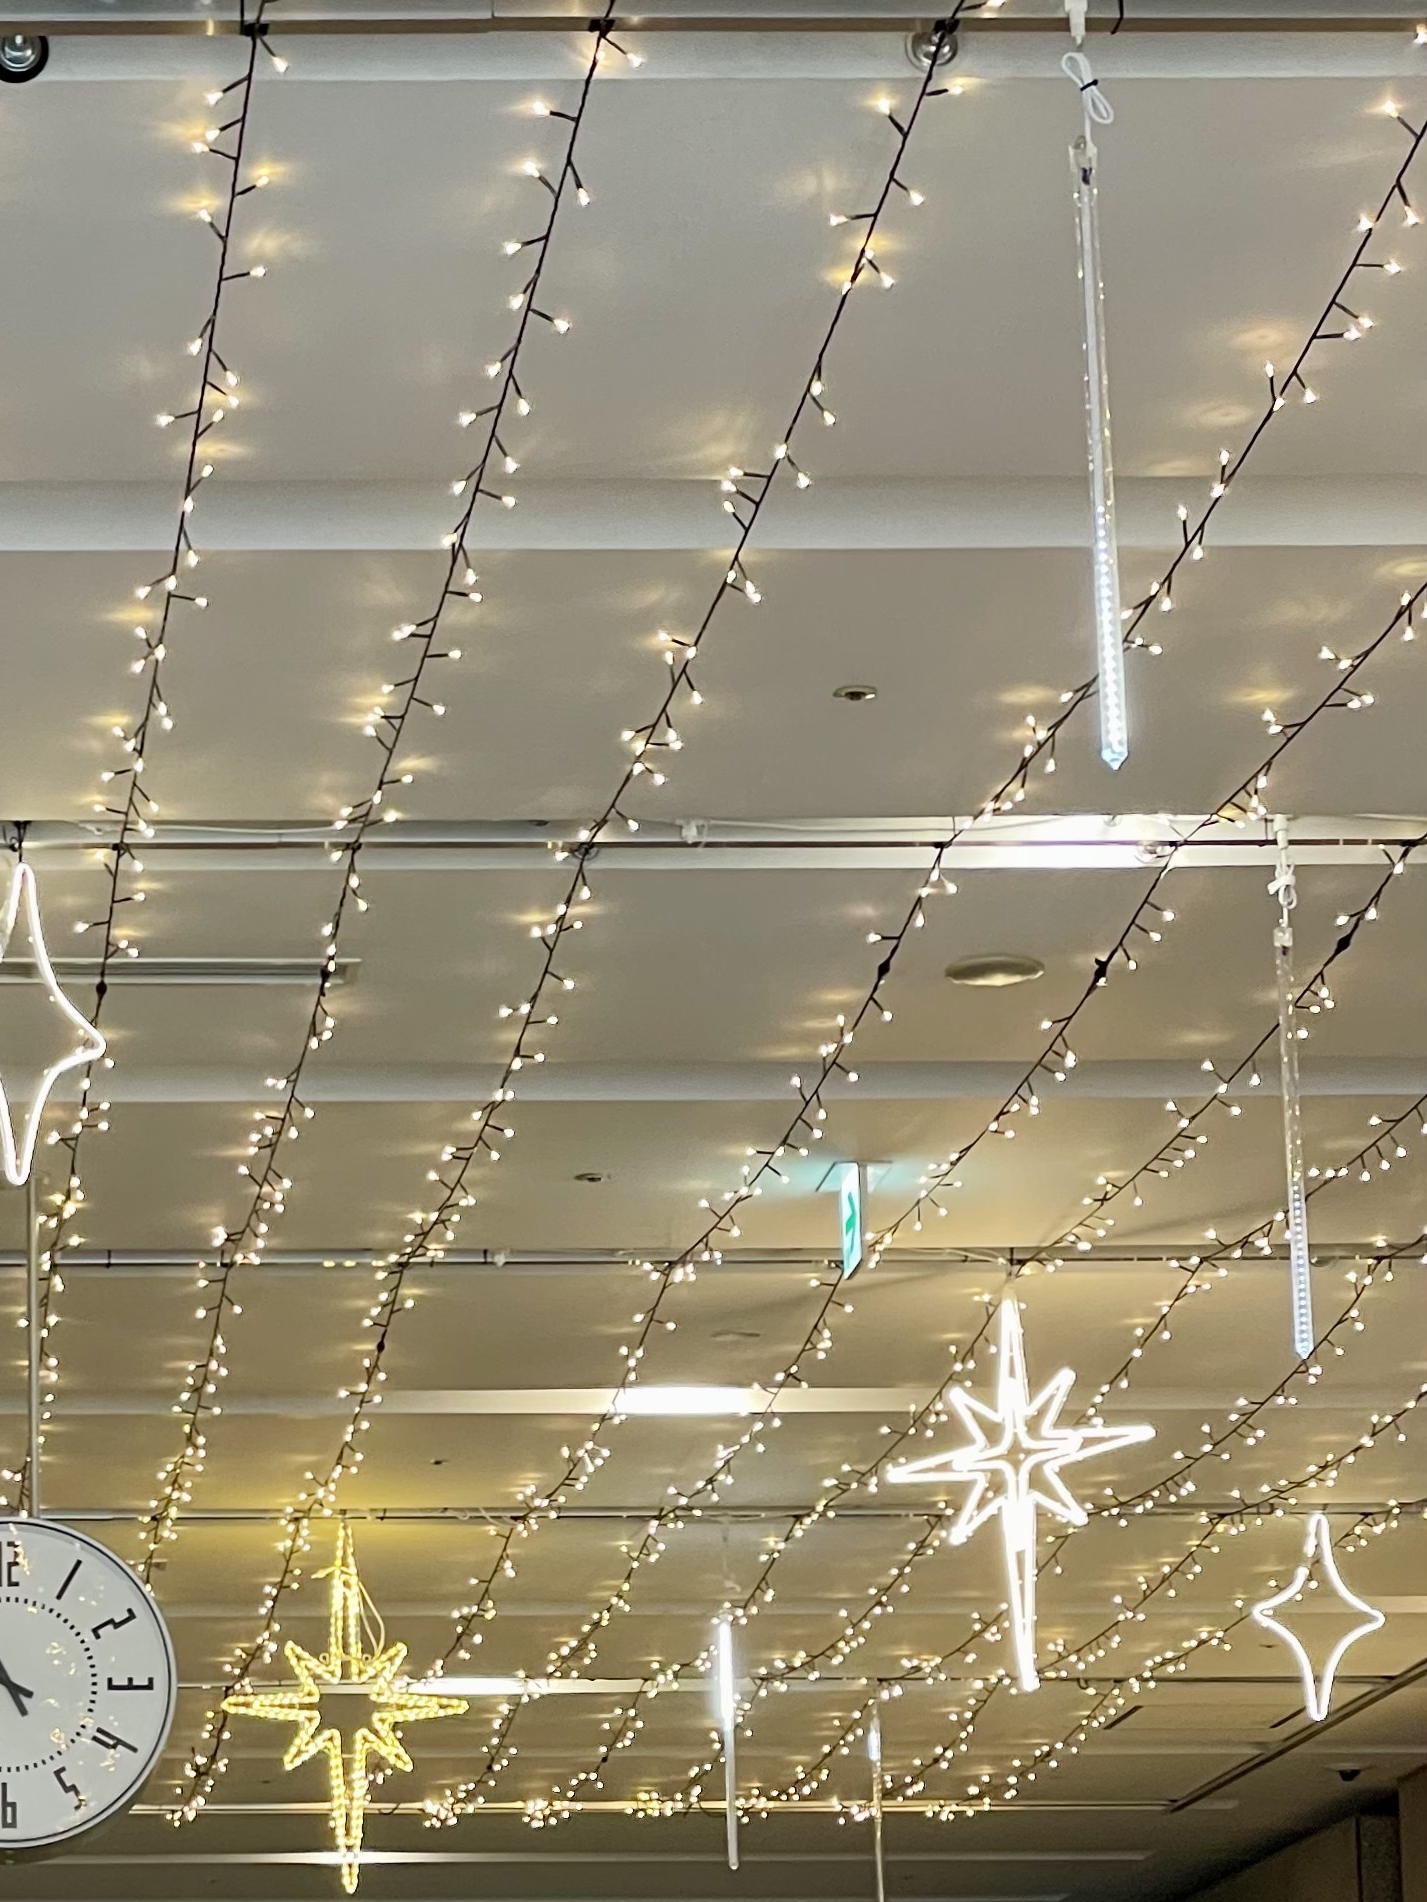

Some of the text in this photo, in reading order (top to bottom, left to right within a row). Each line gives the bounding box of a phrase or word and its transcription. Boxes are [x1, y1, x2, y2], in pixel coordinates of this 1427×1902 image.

[56, 1559, 82, 1600] 1
[90, 1607, 137, 1640] 2
[107, 1676, 154, 1691] 3
[91, 1727, 139, 1754] 4
[1, 1782, 18, 1829] 6
[53, 1766, 87, 1811] 5
